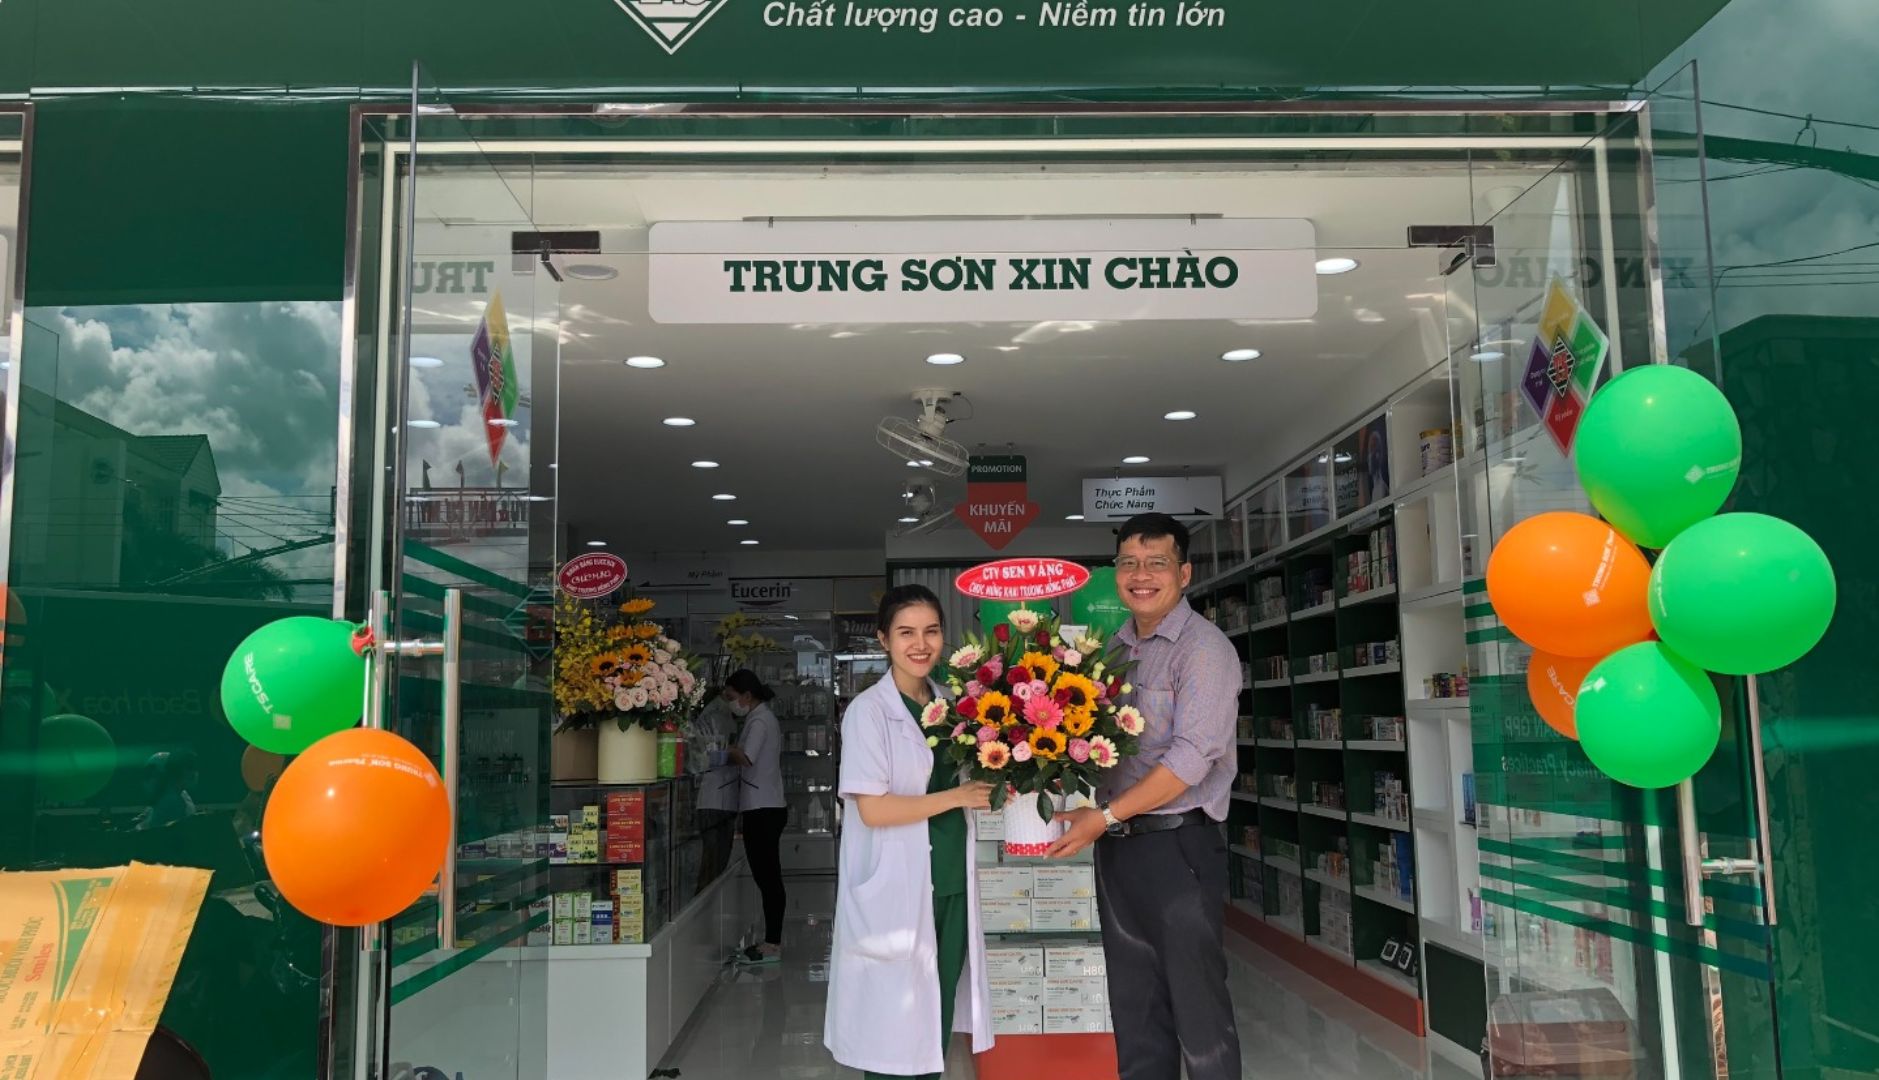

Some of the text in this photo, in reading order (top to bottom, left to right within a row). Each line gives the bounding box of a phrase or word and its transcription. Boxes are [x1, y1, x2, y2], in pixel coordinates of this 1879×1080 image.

[762, 0, 836, 28] Chất
[844, 1, 938, 33] lượng
[948, 8, 1004, 27] cao
[1038, 0, 1118, 27] Niềm
[1127, 2, 1166, 27] tin
[1175, 2, 1226, 27] lớn
[724, 248, 1239, 292] TRUNG SƠN XIN CHÀO
[970, 464, 1022, 473] PROMOTION
[1095, 485, 1156, 499] Thực Phẩm
[969, 499, 1025, 516] KHUYẾN
[1095, 500, 1123, 510] Chức
[984, 518, 1012, 533] MÃI
[982, 566, 1000, 581] CTY
[1002, 565, 1026, 580] SEN
[730, 582, 792, 599] Eucerin
[244, 651, 274, 715] TSCARE
[1546, 664, 1577, 710] CARE
[1082, 966, 1105, 977] H80
